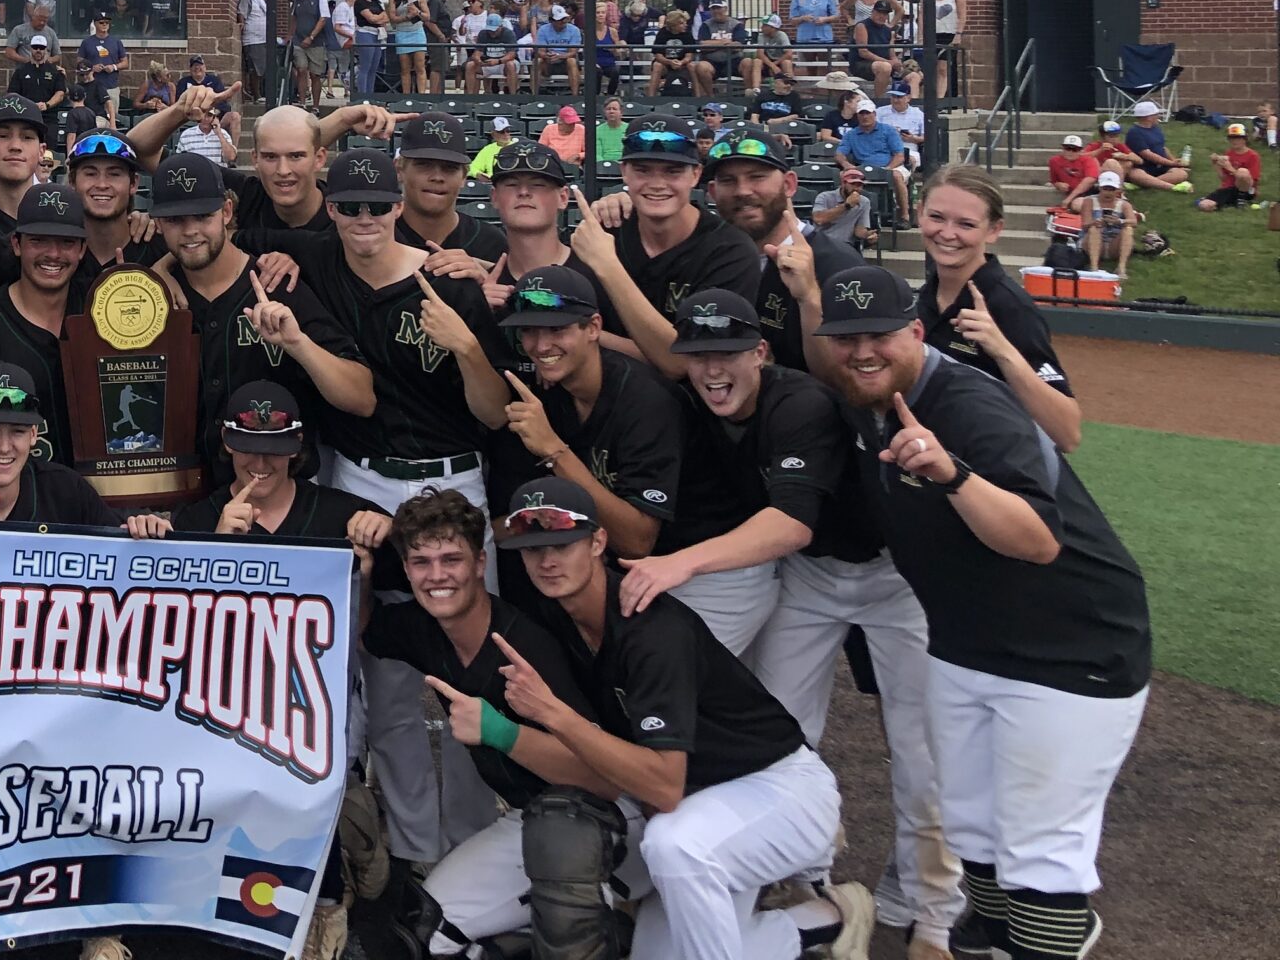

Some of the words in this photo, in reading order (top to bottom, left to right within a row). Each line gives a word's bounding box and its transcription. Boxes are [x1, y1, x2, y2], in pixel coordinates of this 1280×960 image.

[98, 277, 122, 310] COLORADO
[145, 280, 163, 305] SCHOOL
[98, 318, 128, 345] ACTIVITIES
[130, 314, 163, 346] ASSOCIATION
[106, 361, 160, 371] BASEBALL
[96, 460, 126, 470] STATE
[127, 456, 177, 468] CHAMPION
[12, 548, 117, 581] HIGH
[128, 555, 290, 587] SCHOOL
